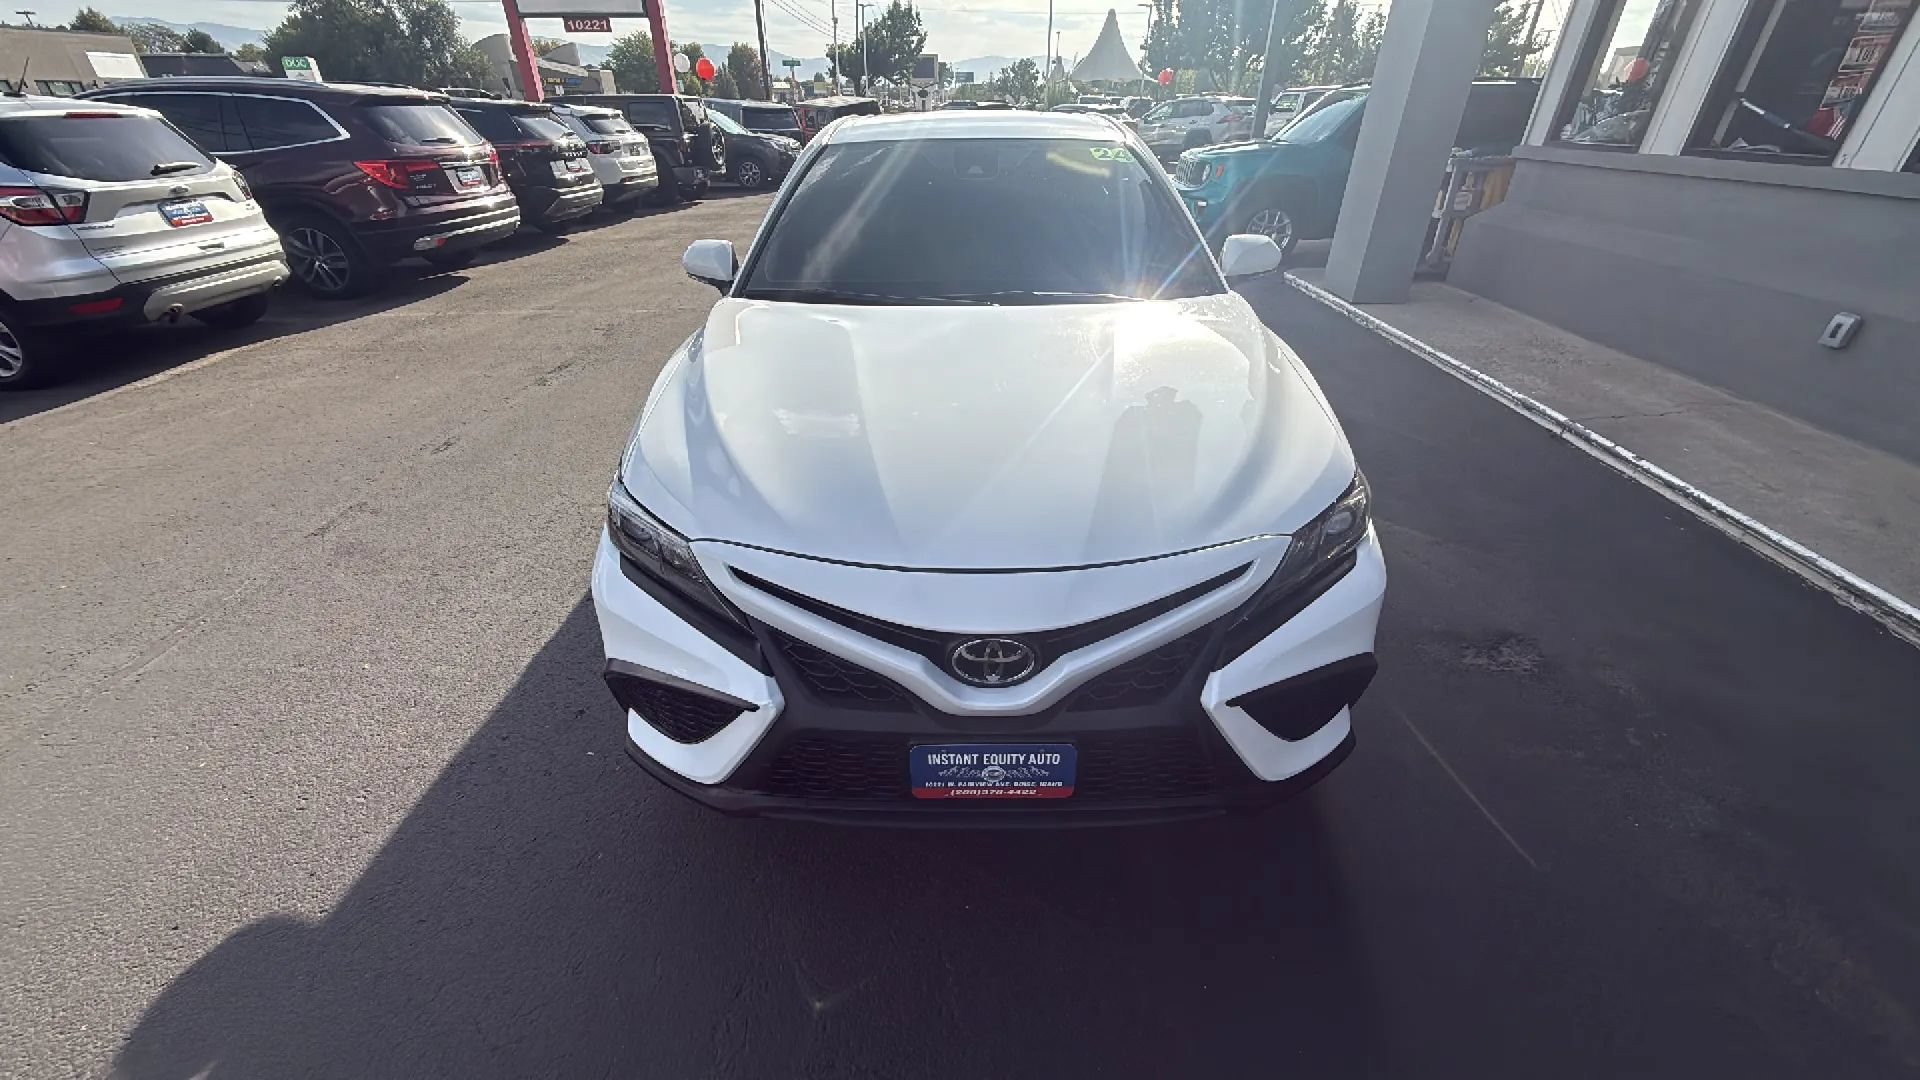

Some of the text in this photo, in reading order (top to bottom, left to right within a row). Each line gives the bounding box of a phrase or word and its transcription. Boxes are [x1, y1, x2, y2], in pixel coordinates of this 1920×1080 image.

[567, 19, 608, 30] 10221
[927, 753, 1061, 766] INSTANT EQUITY AUTO
